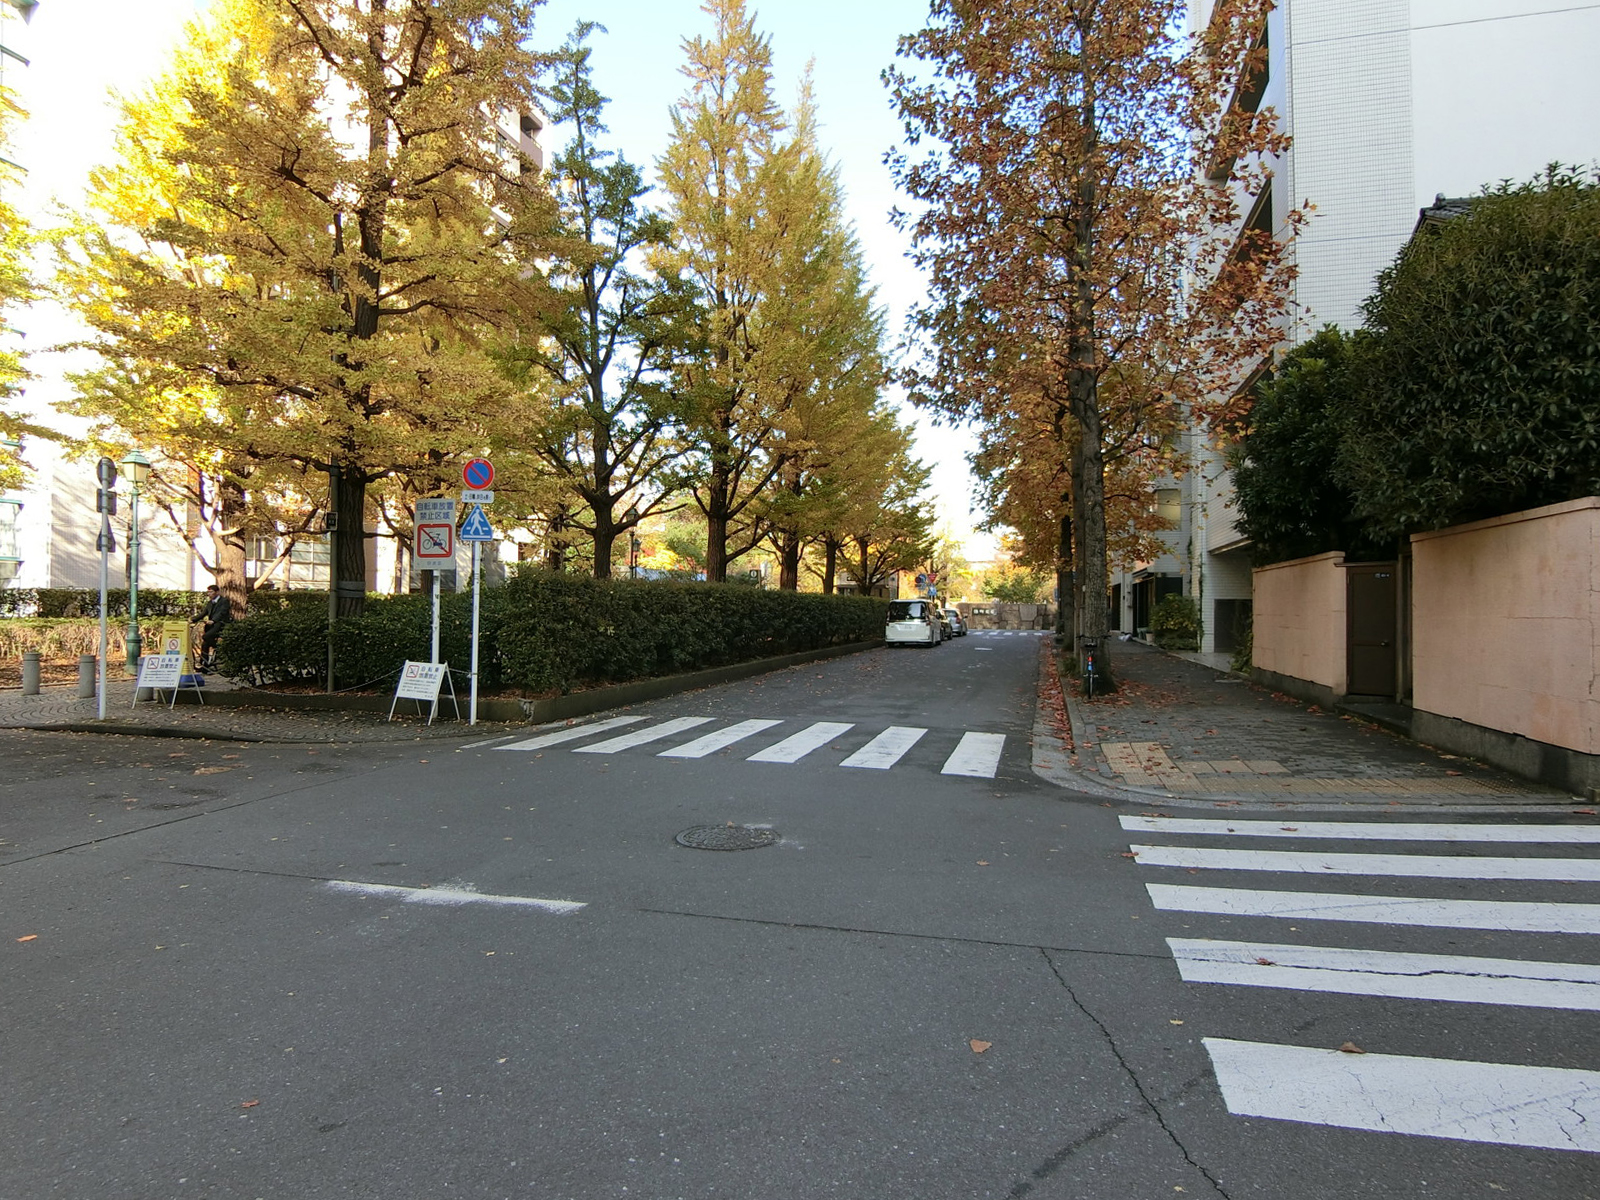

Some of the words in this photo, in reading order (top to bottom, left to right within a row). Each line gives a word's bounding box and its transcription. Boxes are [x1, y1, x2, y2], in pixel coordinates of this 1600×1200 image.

[416, 501, 454, 511] 自転車放置
[420, 511, 450, 520] 禁止区域
